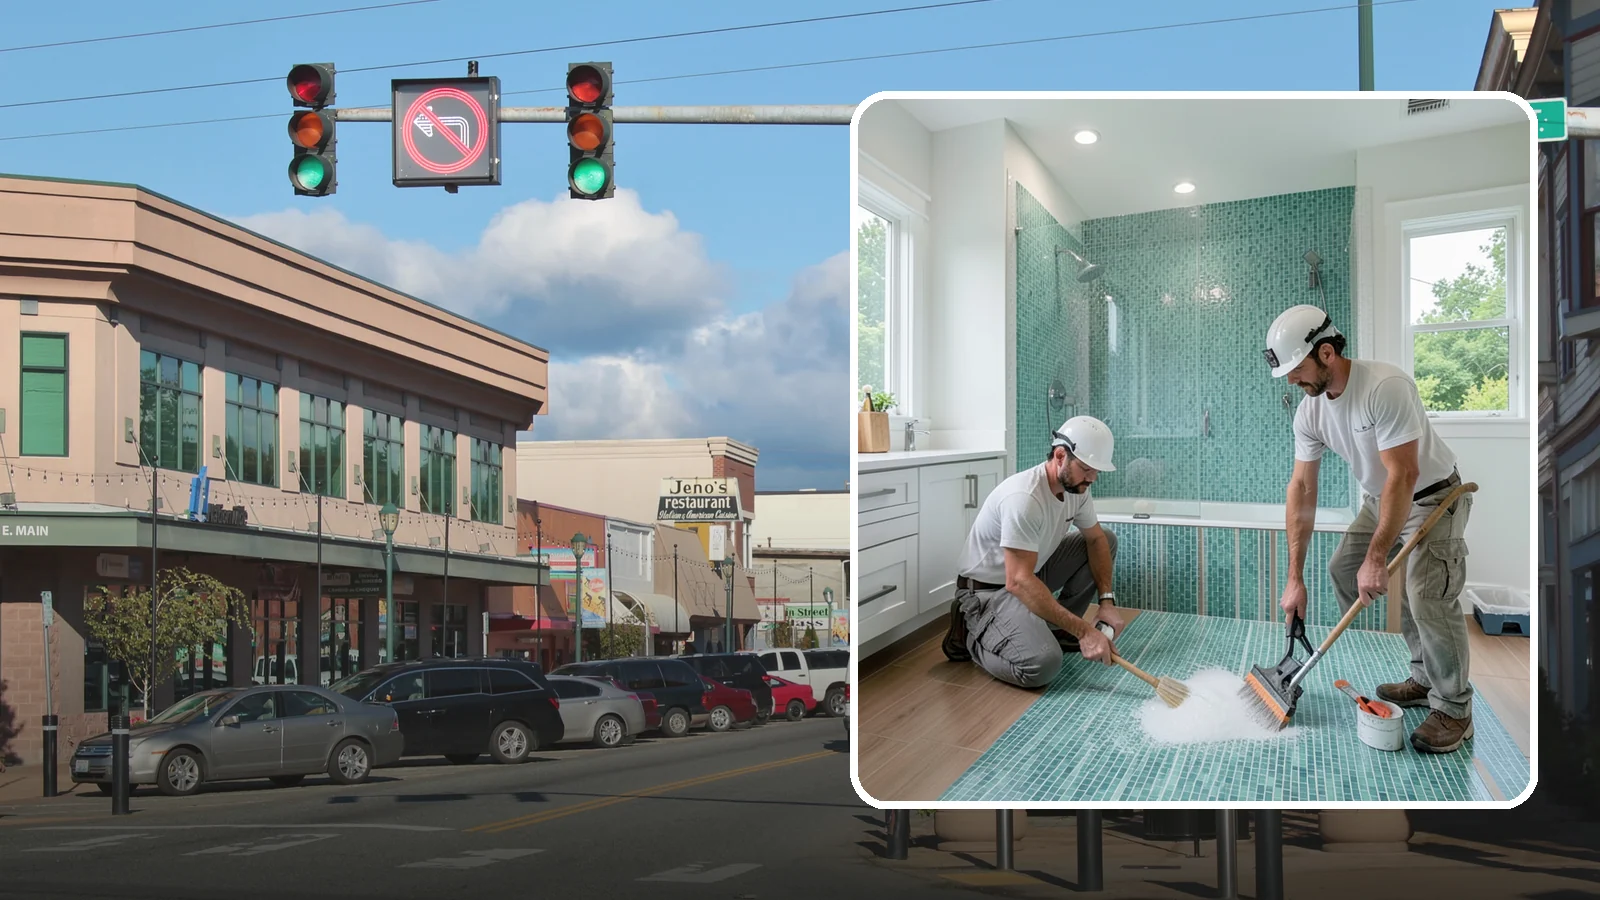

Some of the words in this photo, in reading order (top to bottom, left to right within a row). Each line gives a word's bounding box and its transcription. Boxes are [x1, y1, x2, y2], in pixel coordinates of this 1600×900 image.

[670, 480, 727, 494] Jeno's
[665, 496, 731, 509] restaurant
[686, 509, 714, 519] American
[715, 509, 738, 519] Cuisine
[2, 525, 13, 536] E.
[15, 525, 49, 536] MAIN
[797, 608, 828, 616] Street
[790, 619, 824, 627] lass
